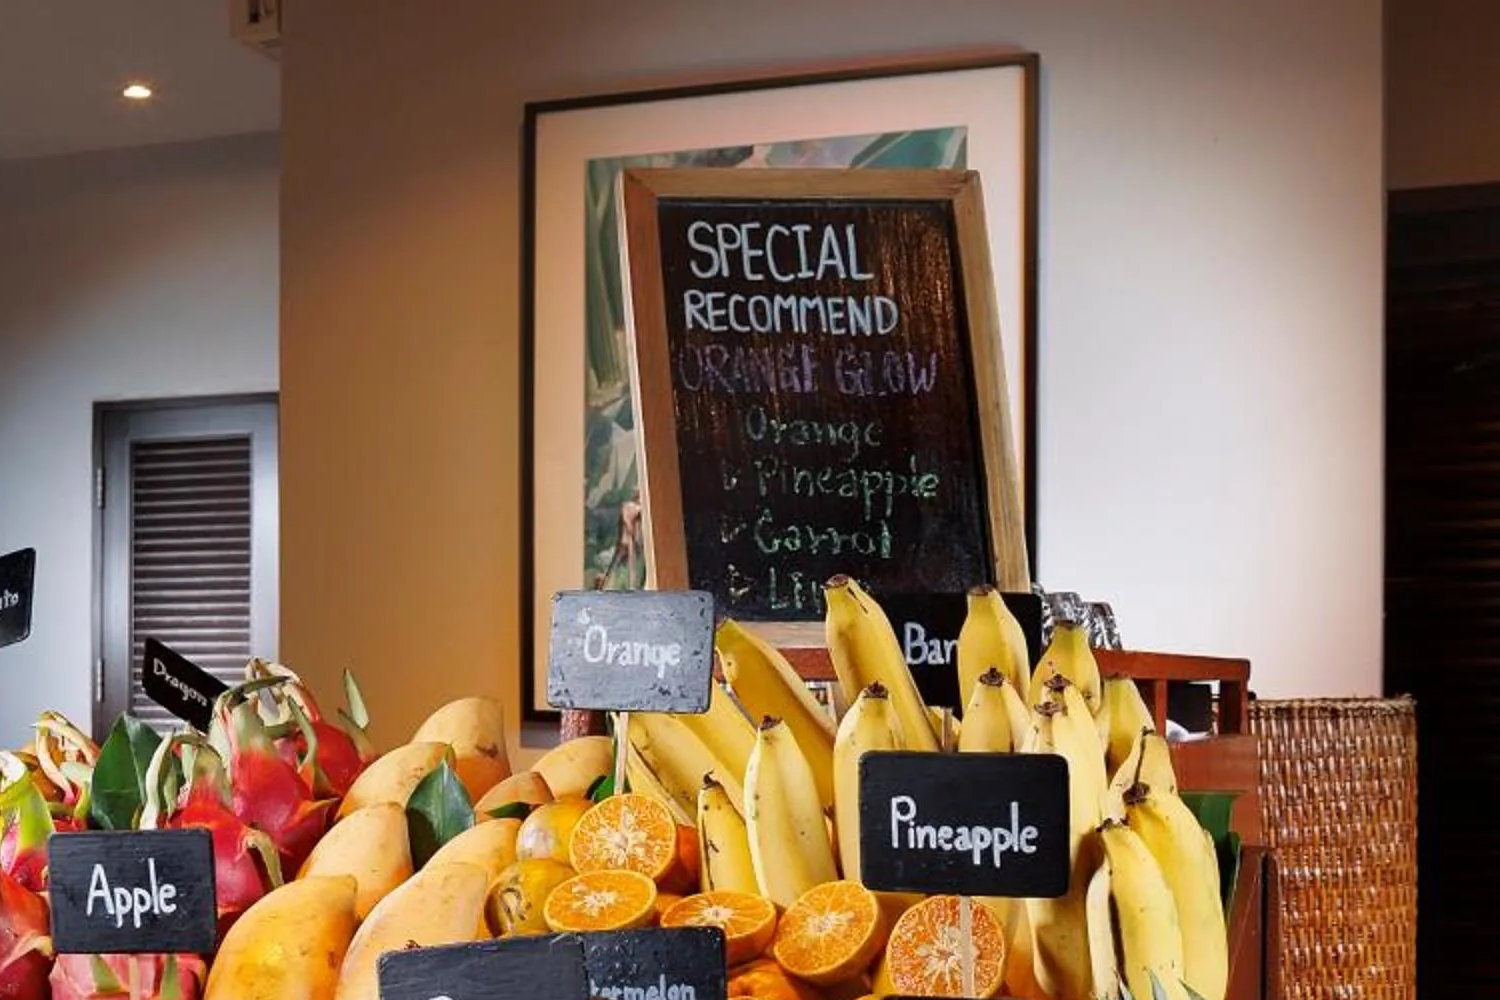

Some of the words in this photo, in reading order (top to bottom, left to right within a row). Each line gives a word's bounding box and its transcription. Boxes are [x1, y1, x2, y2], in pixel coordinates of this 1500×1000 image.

[687, 221, 875, 282] SPECIAL
[683, 289, 900, 336] RECOMMEND
[678, 341, 818, 394] ORANGE
[834, 349, 938, 396] GLOW
[746, 405, 882, 461] Orange
[754, 453, 940, 521] Pineapple
[583, 624, 682, 679] Orange
[152, 657, 208, 707] Dragon
[891, 795, 1039, 868] Pineapple
[86, 857, 177, 928] Apple
